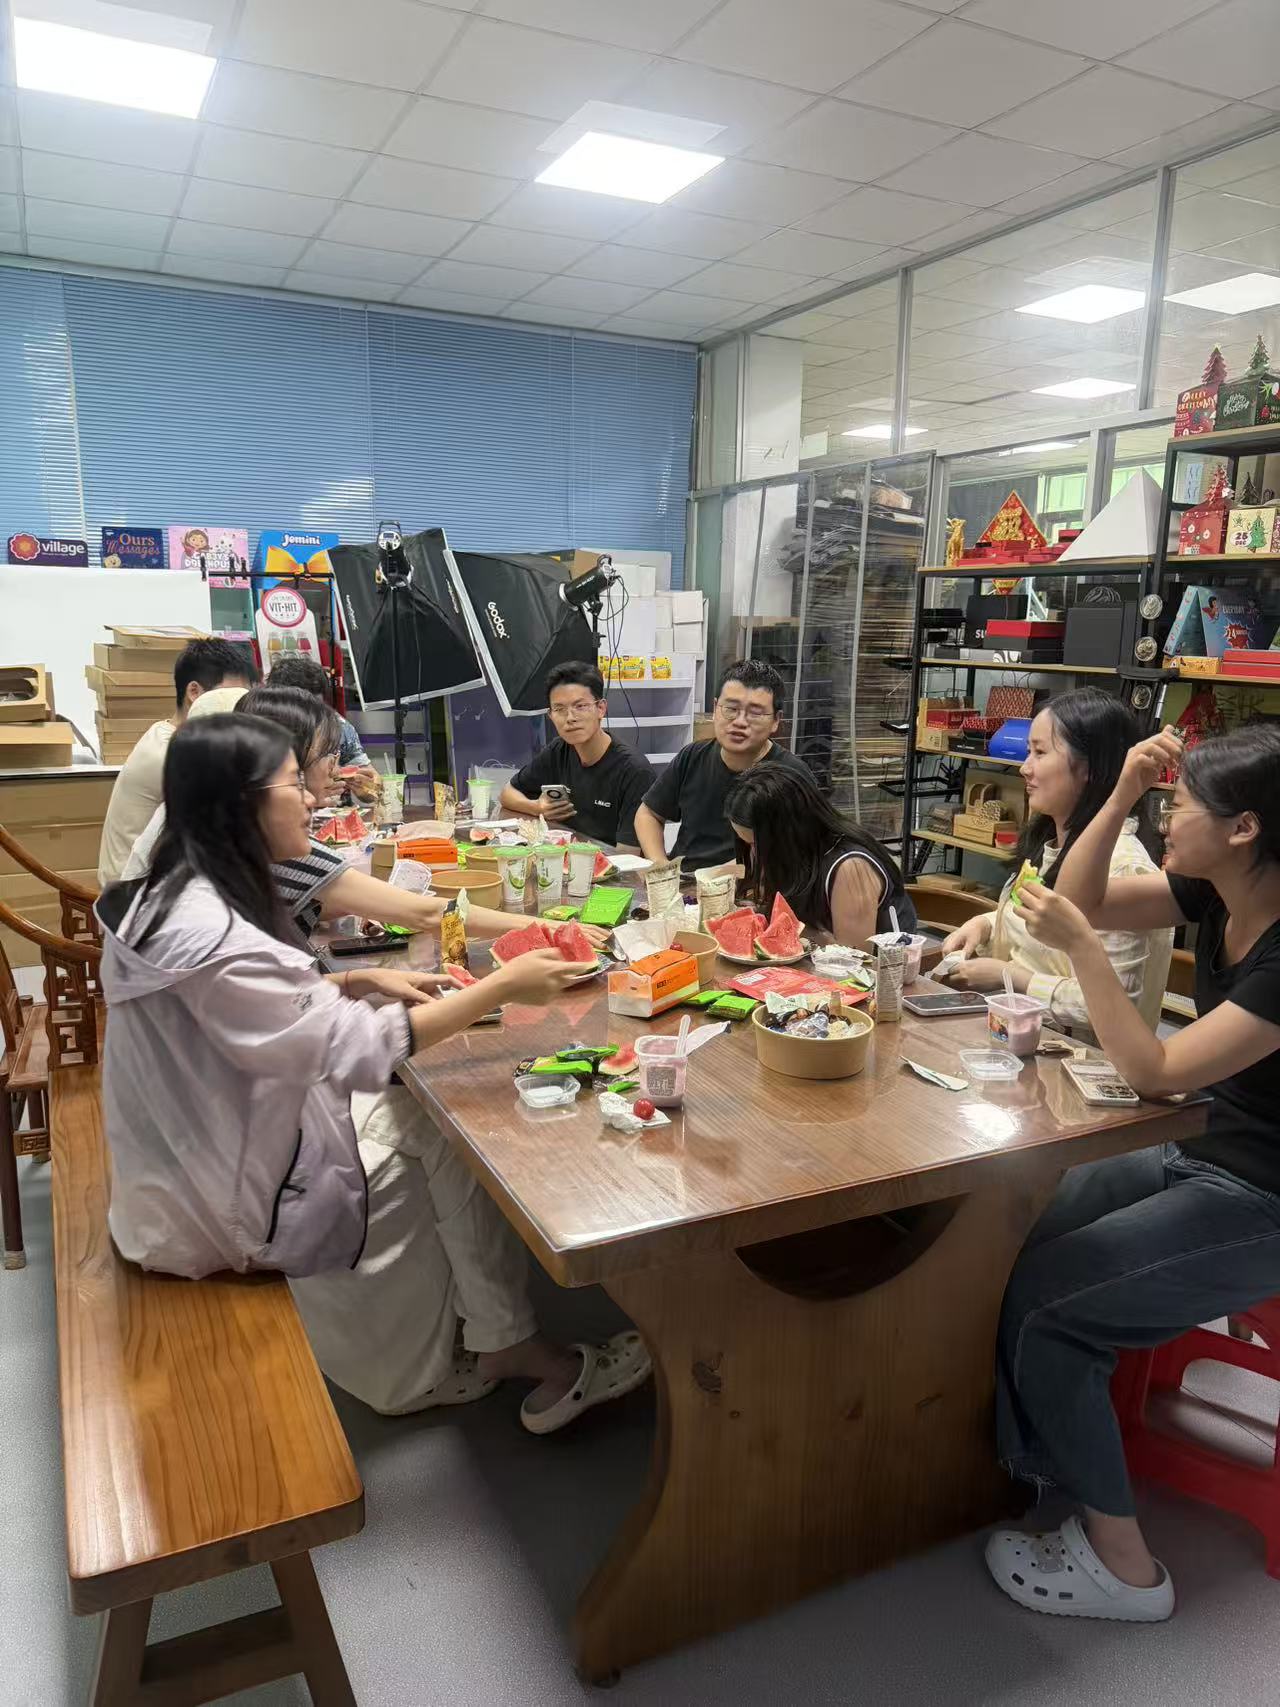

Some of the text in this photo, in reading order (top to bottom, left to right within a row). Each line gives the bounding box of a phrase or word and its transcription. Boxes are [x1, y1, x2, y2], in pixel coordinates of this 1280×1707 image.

[119, 533, 155, 546] Ours
[1235, 532, 1249, 540] 25
[42, 540, 85, 556] village
[487, 601, 508, 639] Godox
